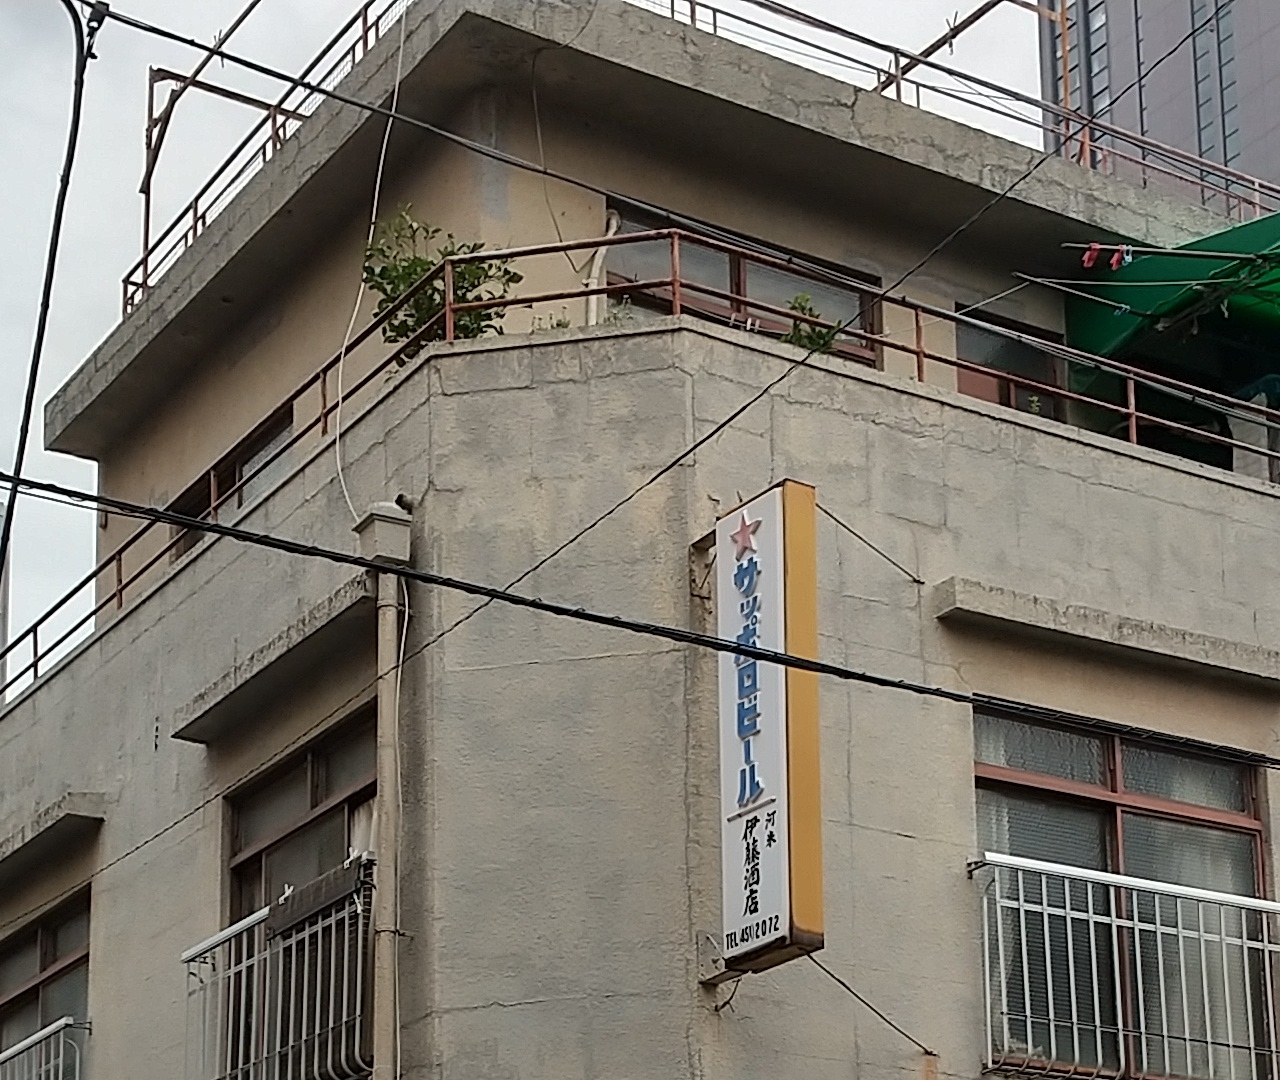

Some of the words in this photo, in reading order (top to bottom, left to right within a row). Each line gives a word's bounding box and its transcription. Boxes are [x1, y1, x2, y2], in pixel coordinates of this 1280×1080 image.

[741, 815, 760, 917] 伊藤酒店
[725, 931, 739, 950] TEL
